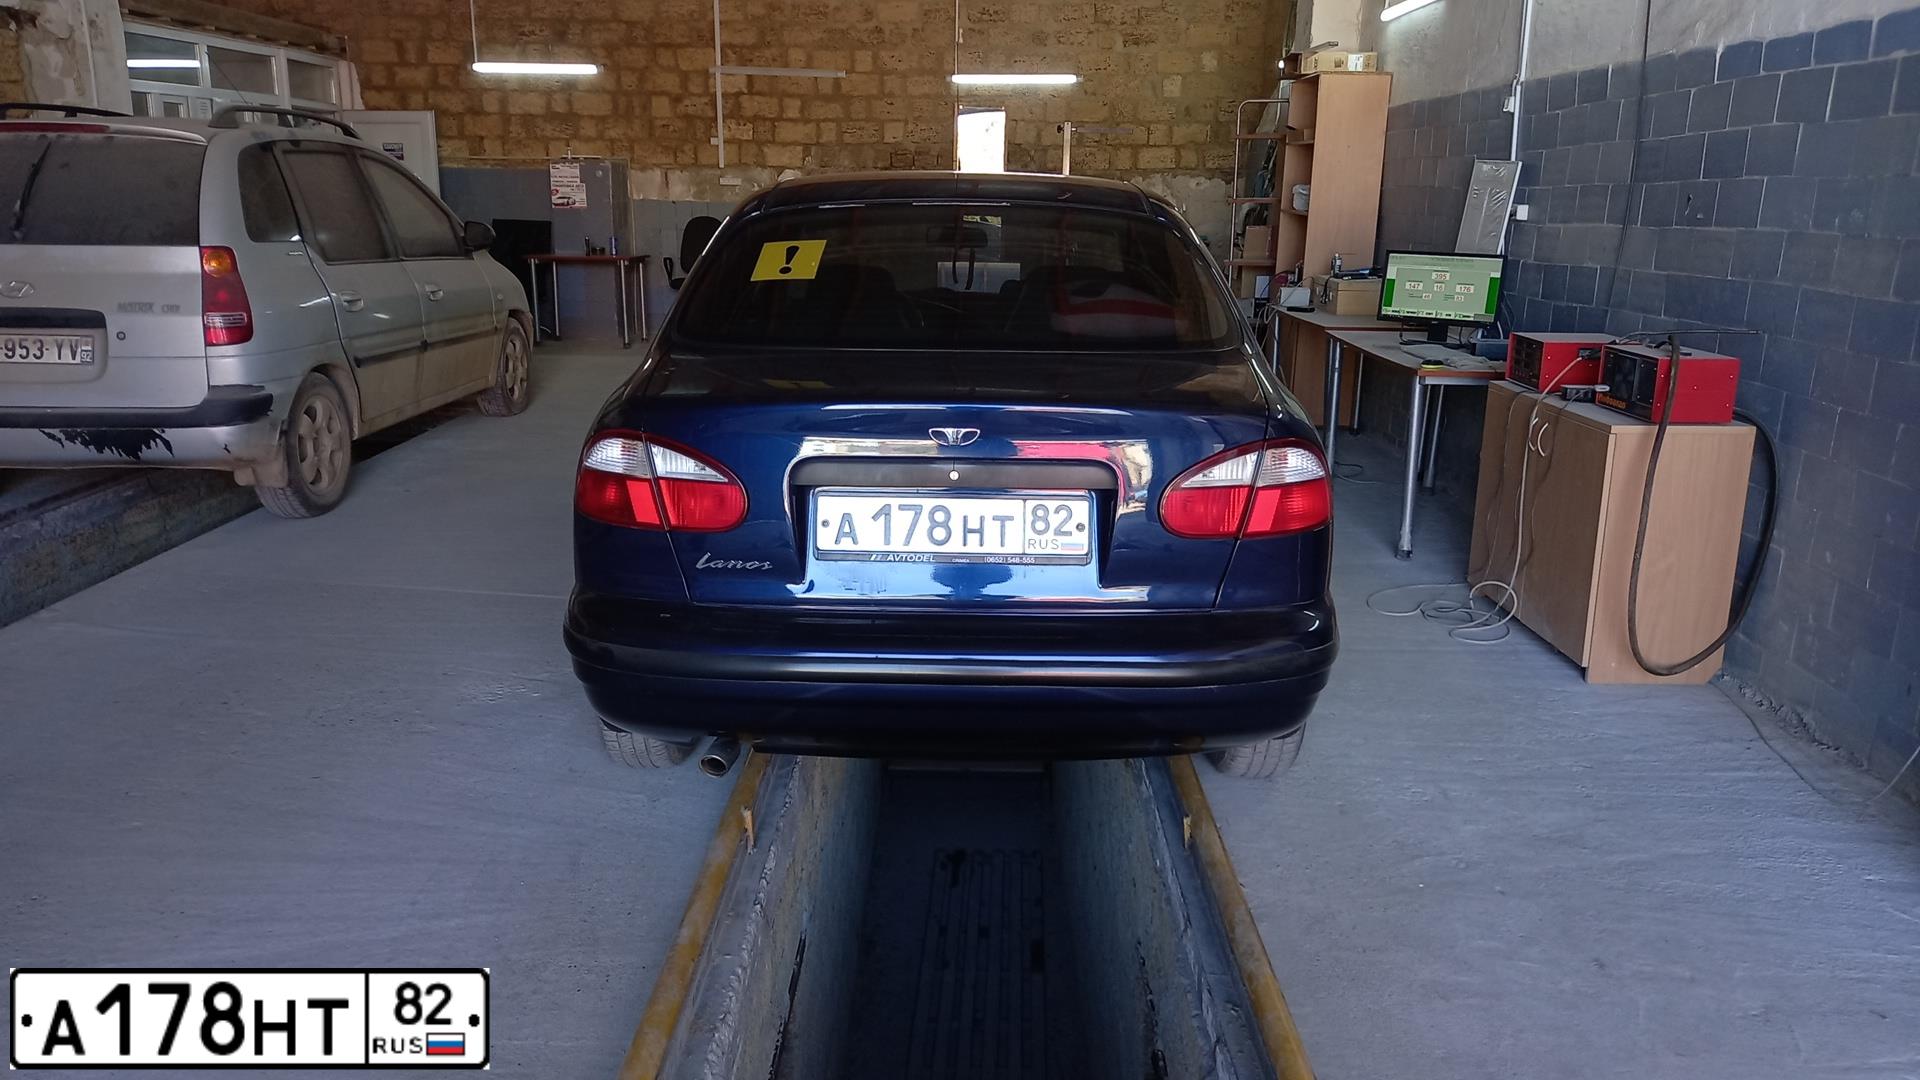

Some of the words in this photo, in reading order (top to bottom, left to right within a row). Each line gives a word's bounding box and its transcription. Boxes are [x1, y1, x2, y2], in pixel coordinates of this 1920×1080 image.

[1030, 503, 1073, 537] 82
[1028, 538, 1059, 550] RUS
[886, 553, 936, 562] AVTODEL
